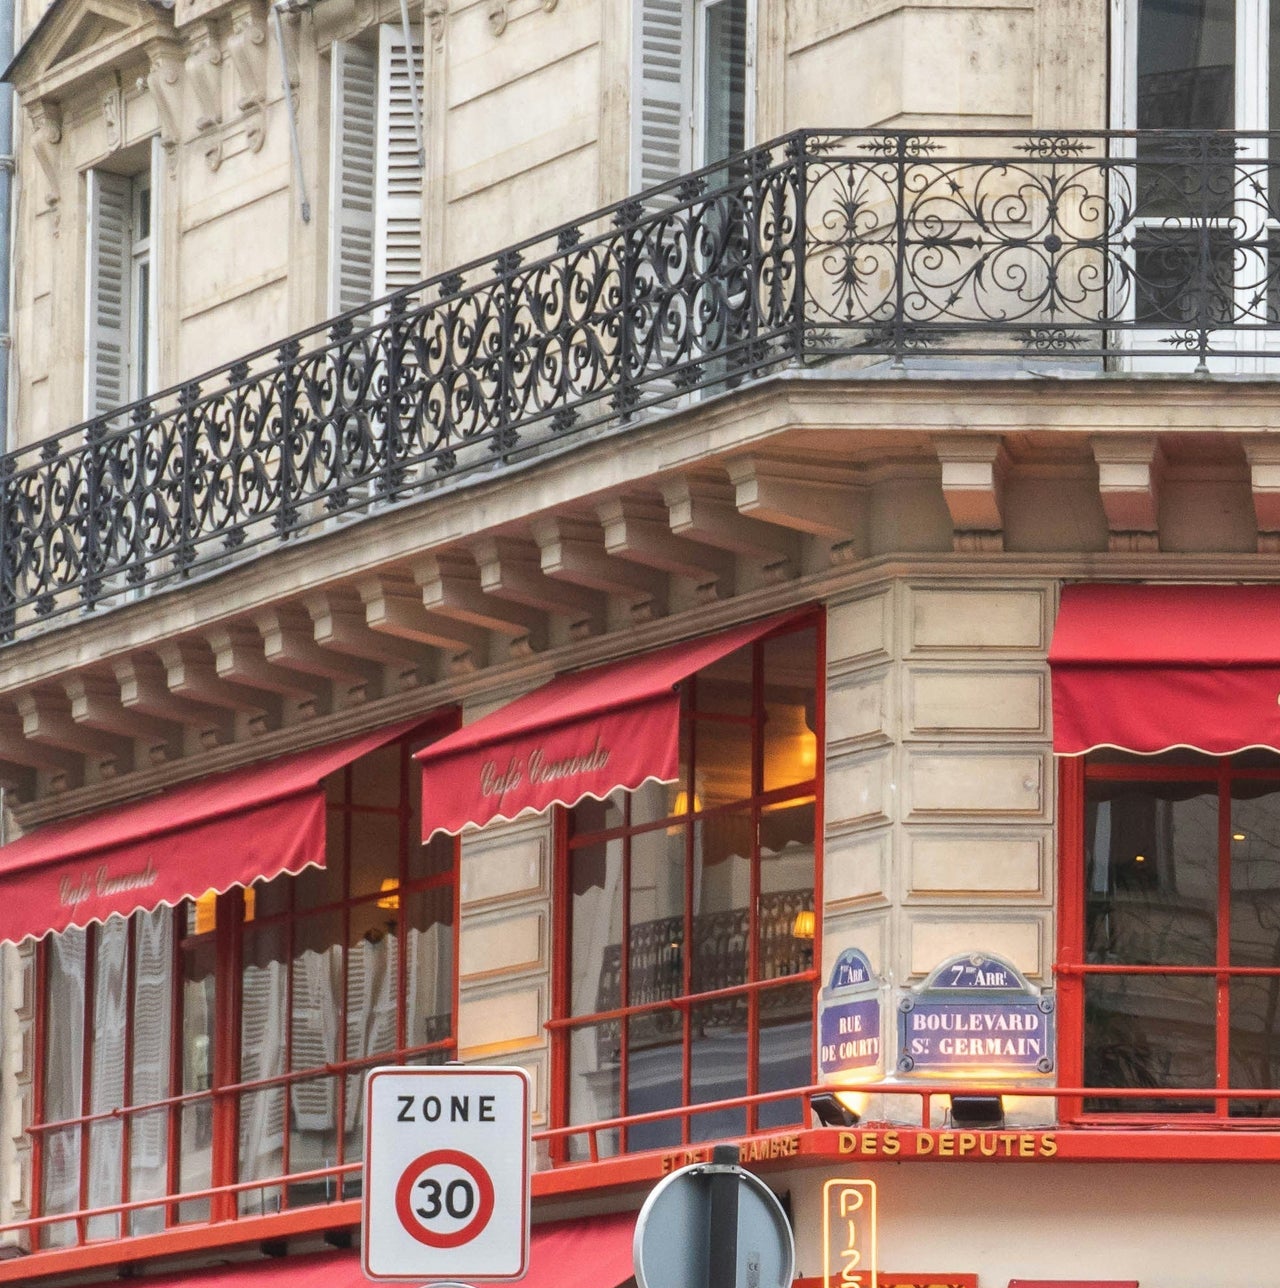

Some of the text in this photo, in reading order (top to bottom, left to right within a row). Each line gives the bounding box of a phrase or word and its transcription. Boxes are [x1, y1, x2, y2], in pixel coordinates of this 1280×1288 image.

[480, 735, 612, 810] Café Concorde
[839, 1015, 861, 1034] RUE
[912, 1014, 1039, 1031] BOULEVARD
[821, 1037, 880, 1063] DE COURTY
[939, 1038, 1041, 1056] GERMAIN
[397, 1095, 496, 1123] ZONE
[740, 1134, 800, 1162] HAMBRE
[838, 1131, 901, 1155] DES
[416, 1178, 475, 1219] 30
